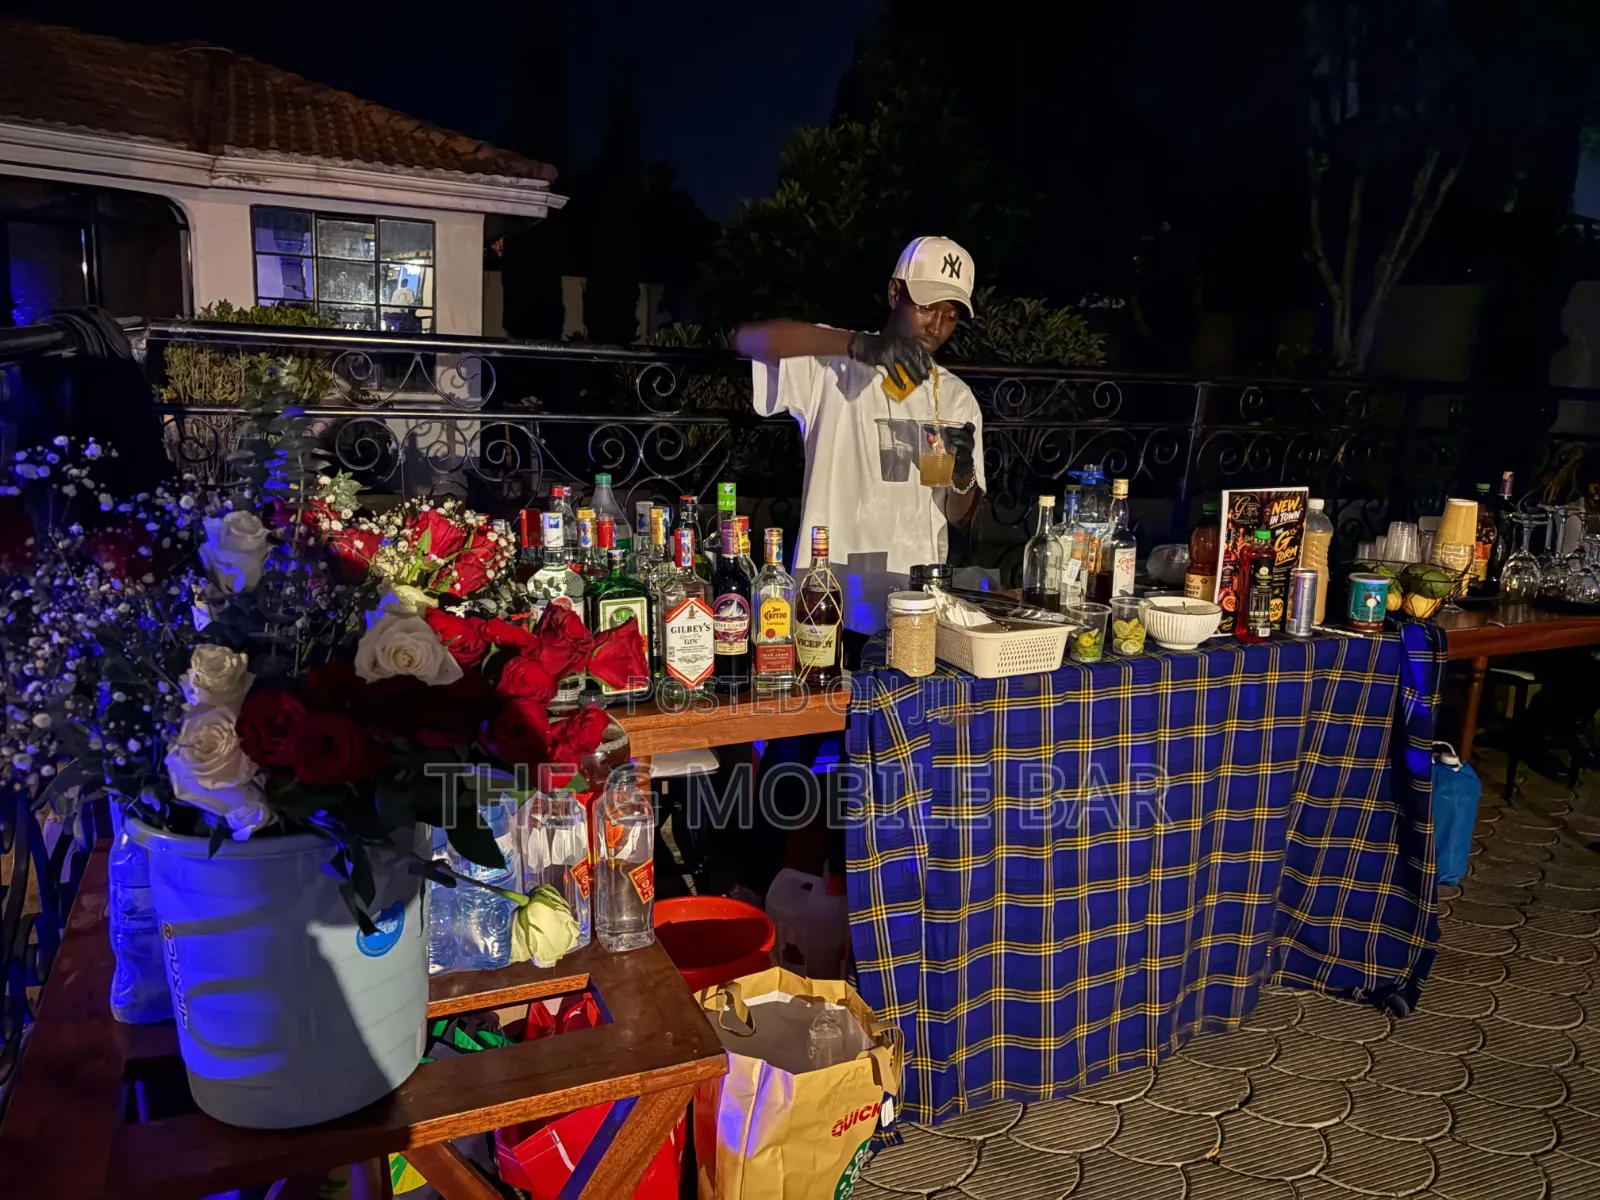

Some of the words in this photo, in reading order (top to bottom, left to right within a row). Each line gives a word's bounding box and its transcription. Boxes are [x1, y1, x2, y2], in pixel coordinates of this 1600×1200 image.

[941, 252, 962, 279] NY
[1271, 496, 1300, 515] NEW
[1269, 514, 1279, 525] IN
[1280, 510, 1301, 523] TOWN
[1274, 530, 1294, 551] G
[764, 610, 787, 620] Cuervo
[670, 622, 711, 634] GILBEY'S
